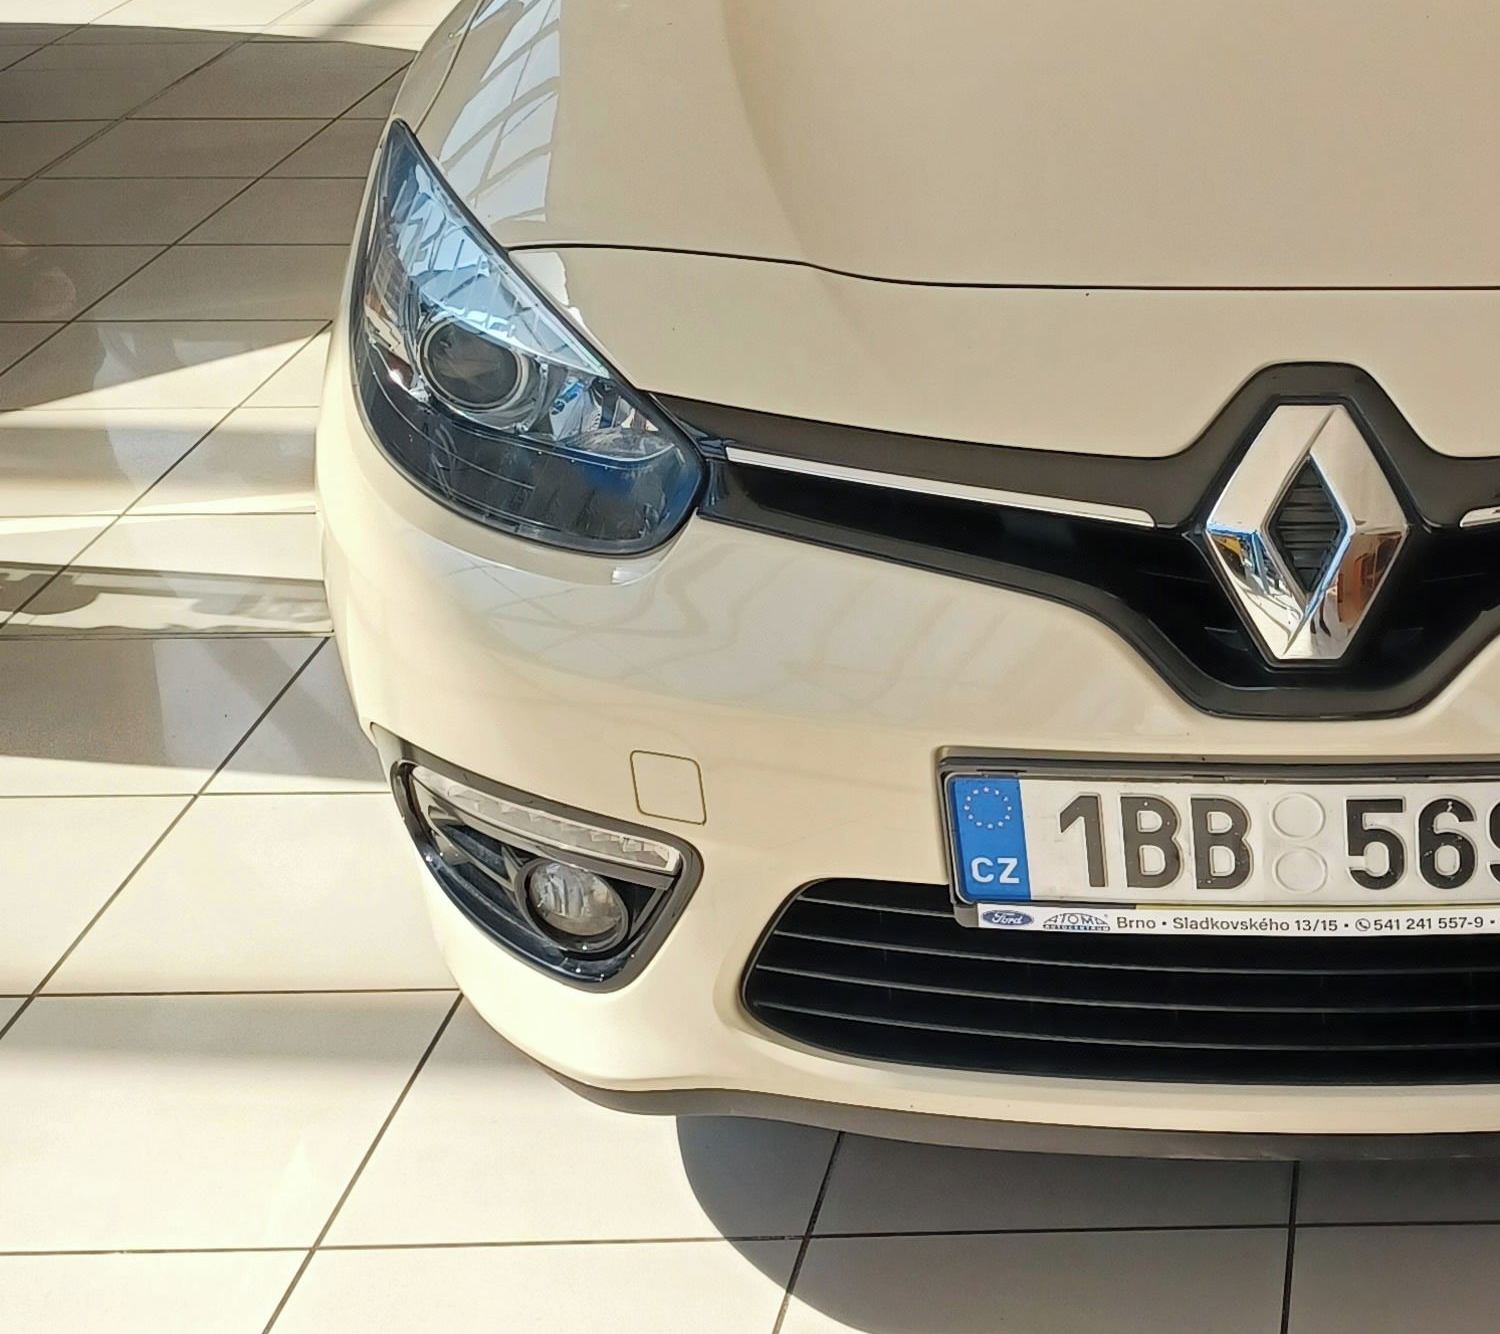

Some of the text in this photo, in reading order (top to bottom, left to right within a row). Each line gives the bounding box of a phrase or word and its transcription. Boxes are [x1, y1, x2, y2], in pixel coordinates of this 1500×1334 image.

[1059, 795, 1253, 889] 1BB
[970, 856, 1020, 884] CZ
[988, 910, 1026, 926] Ford
[1043, 912, 1108, 925] ATOMA
[1116, 916, 1157, 930] Brno
[1172, 916, 1291, 932] Sladkovského
[1294, 918, 1339, 932] 13/15
[1373, 917, 1401, 931] 541
[1405, 917, 1433, 931] 241
[1437, 916, 1485, 930] 557-9
[1042, 923, 1111, 932] AUTOCENTRUM
